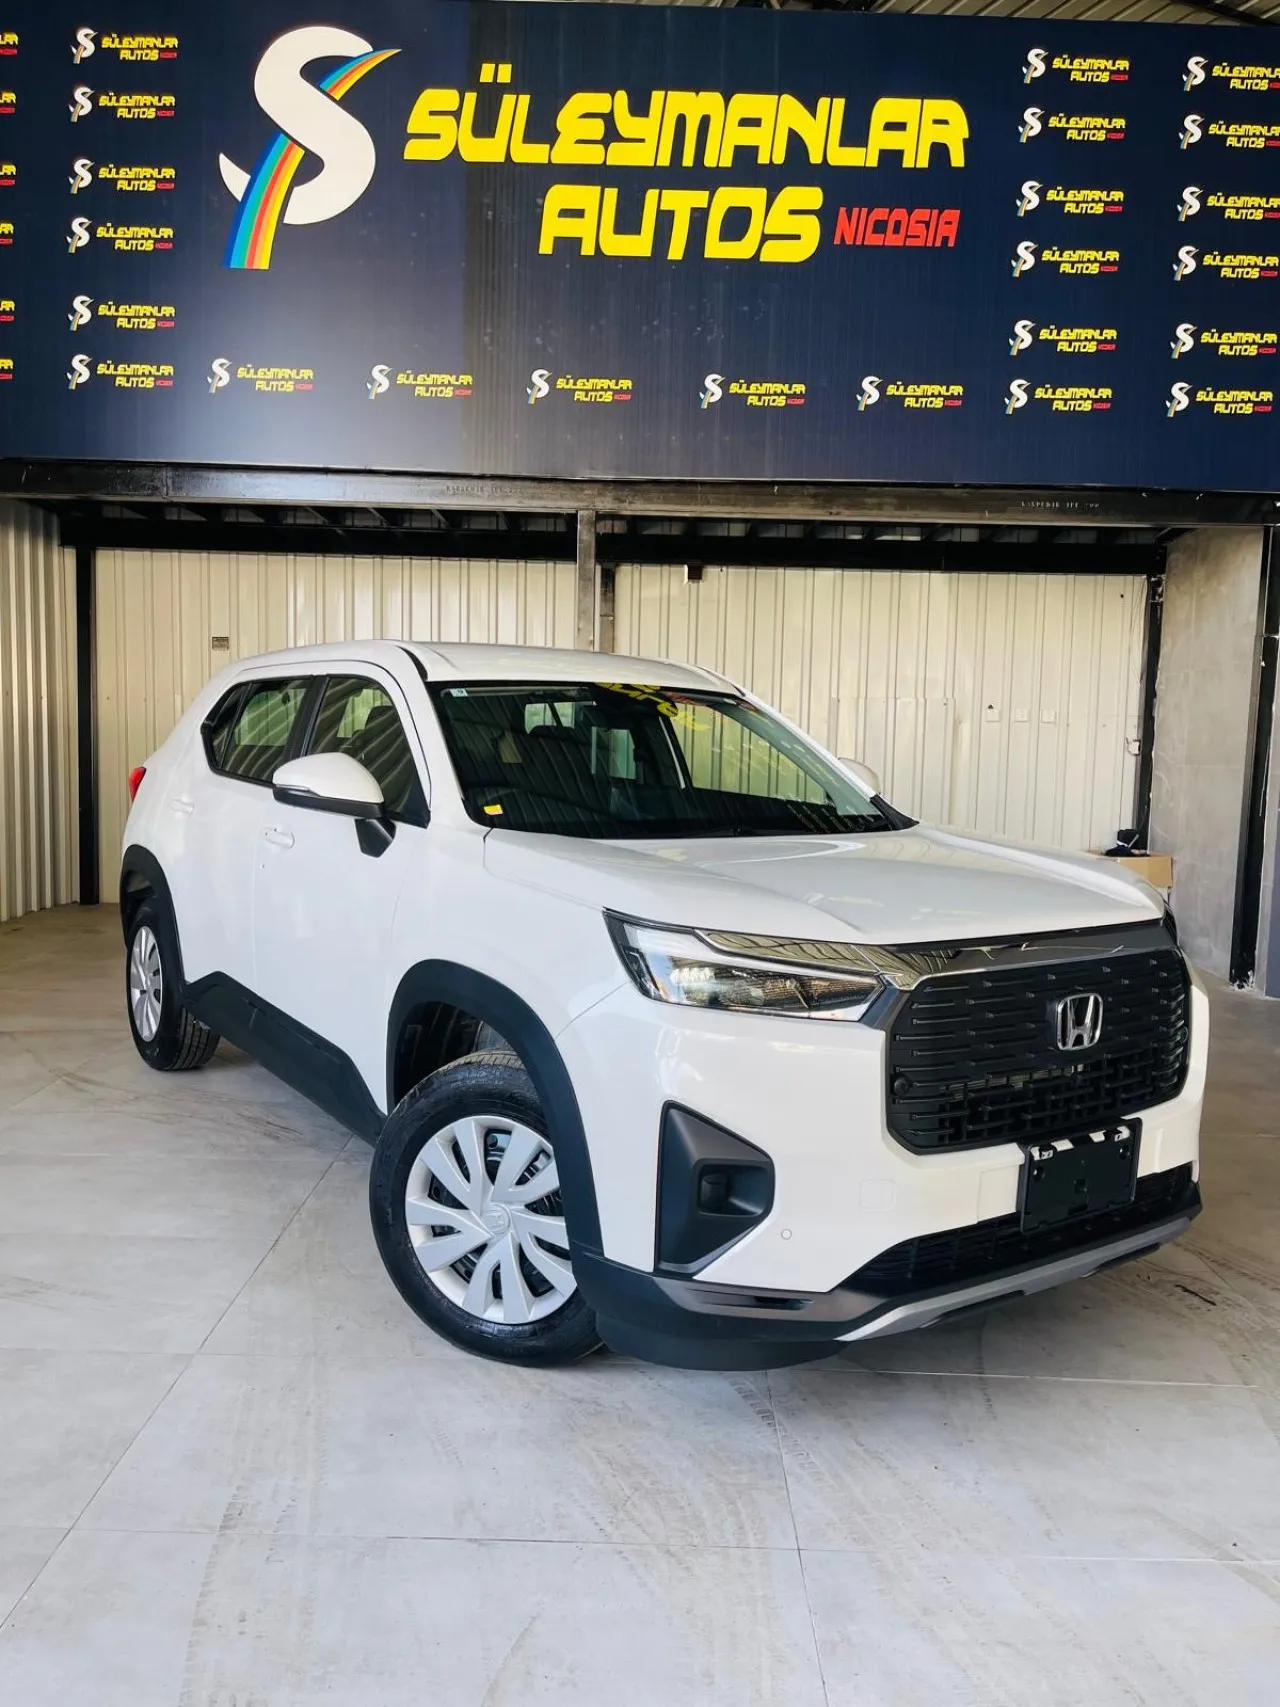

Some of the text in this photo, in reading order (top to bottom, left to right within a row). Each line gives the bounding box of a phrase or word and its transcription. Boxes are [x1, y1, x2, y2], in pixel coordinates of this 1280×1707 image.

[101, 33, 178, 49] SÜLEYMANLAR
[119, 49, 160, 61] AUTOS
[1052, 54, 1129, 71] SÜLEYMANLAR
[1070, 70, 1111, 83] AUTOS
[1212, 62, 1280, 79] SÜLEYMANLA
[1229, 79, 1269, 91] AUTOS
[98, 92, 175, 107] SÜLEYMANLAR
[116, 107, 157, 119] AUTOS
[403, 63, 970, 169] SÜLEYMANLAR
[1048, 113, 1125, 129] SÜLEYMANLAR
[1066, 129, 1107, 142] AUTOS
[1226, 137, 1265, 149] AUTOS
[98, 164, 175, 179] SÜLEYMANLAR
[116, 180, 157, 192] AUTOS
[1045, 186, 1124, 202] SÜLEYMANLAR
[1064, 202, 1105, 215] AUTOS
[1224, 208, 1264, 221] AUTOS
[538, 184, 961, 263] AUTOS NICOSIA
[96, 223, 173, 239] SÜLEYMANLAR
[114, 239, 155, 252] AUTOS
[1041, 246, 1119, 262] SÜLEYMANLAR
[1203, 251, 1279, 267] SÜLEYMANLAR
[1059, 263, 1100, 275] AUTOS
[1220, 267, 1260, 279] AUTOS
[97, 301, 175, 318] SÜLEYMANLAR
[116, 317, 157, 330] AUTOS
[1039, 325, 1117, 341] SÜLEYMANLAR
[1200, 329, 1277, 344] SÜLEYMANLAR
[1056, 341, 1098, 353] AUTOS
[1218, 345, 1258, 356] AUTOS
[96, 360, 173, 377] SÜLEYMANLAR
[237, 365, 314, 380] SÜLEYMANLAR
[114, 377, 155, 389] AUTOS
[396, 370, 473, 386] SÜLEYMANLAR
[555, 375, 632, 391] SÜLEYMANLAR
[254, 380, 295, 392] AUTOS
[414, 386, 455, 398] AUTOS
[728, 380, 805, 395] SÜLEYMANLAR
[886, 381, 963, 397] SÜLEYMANLAR
[1034, 384, 1112, 400] SÜLEYMANLAR
[573, 390, 614, 403] AUTOS
[746, 395, 787, 408] AUTOS
[1196, 387, 1272, 402] SÜLEYMANLAR
[904, 397, 944, 409] AUTOS
[1052, 400, 1093, 412] AUTOS
[1213, 403, 1254, 414] AUTOS
